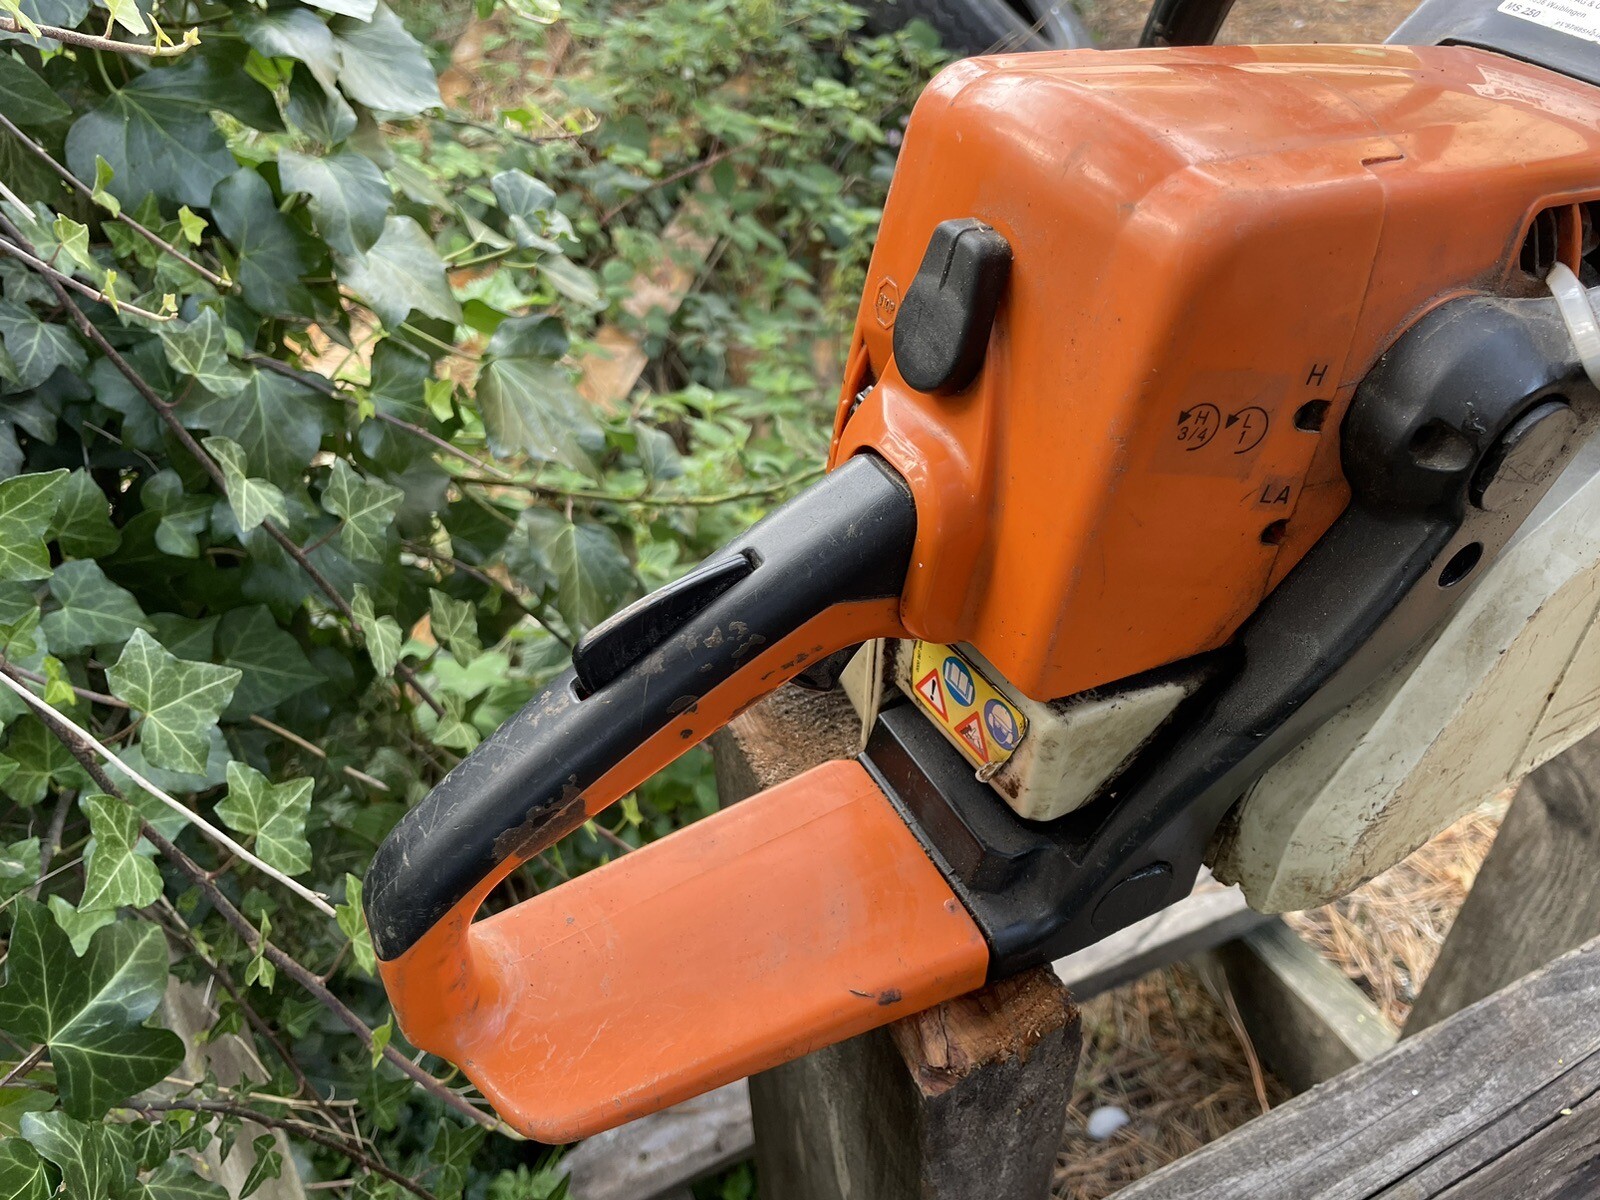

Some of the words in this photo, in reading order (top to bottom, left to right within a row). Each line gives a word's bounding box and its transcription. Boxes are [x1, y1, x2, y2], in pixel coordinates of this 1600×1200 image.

[1505, 2, 1523, 12] MS
[1521, 7, 1541, 18] 250
[1546, 1, 1587, 18] Waiblingen
[878, 292, 896, 312] STOP
[1305, 364, 1328, 387] H
[1194, 410, 1210, 425] H
[1243, 414, 1252, 429] L
[1177, 426, 1208, 442] 3/4
[1238, 430, 1246, 445] 1
[1259, 485, 1291, 505] LA
